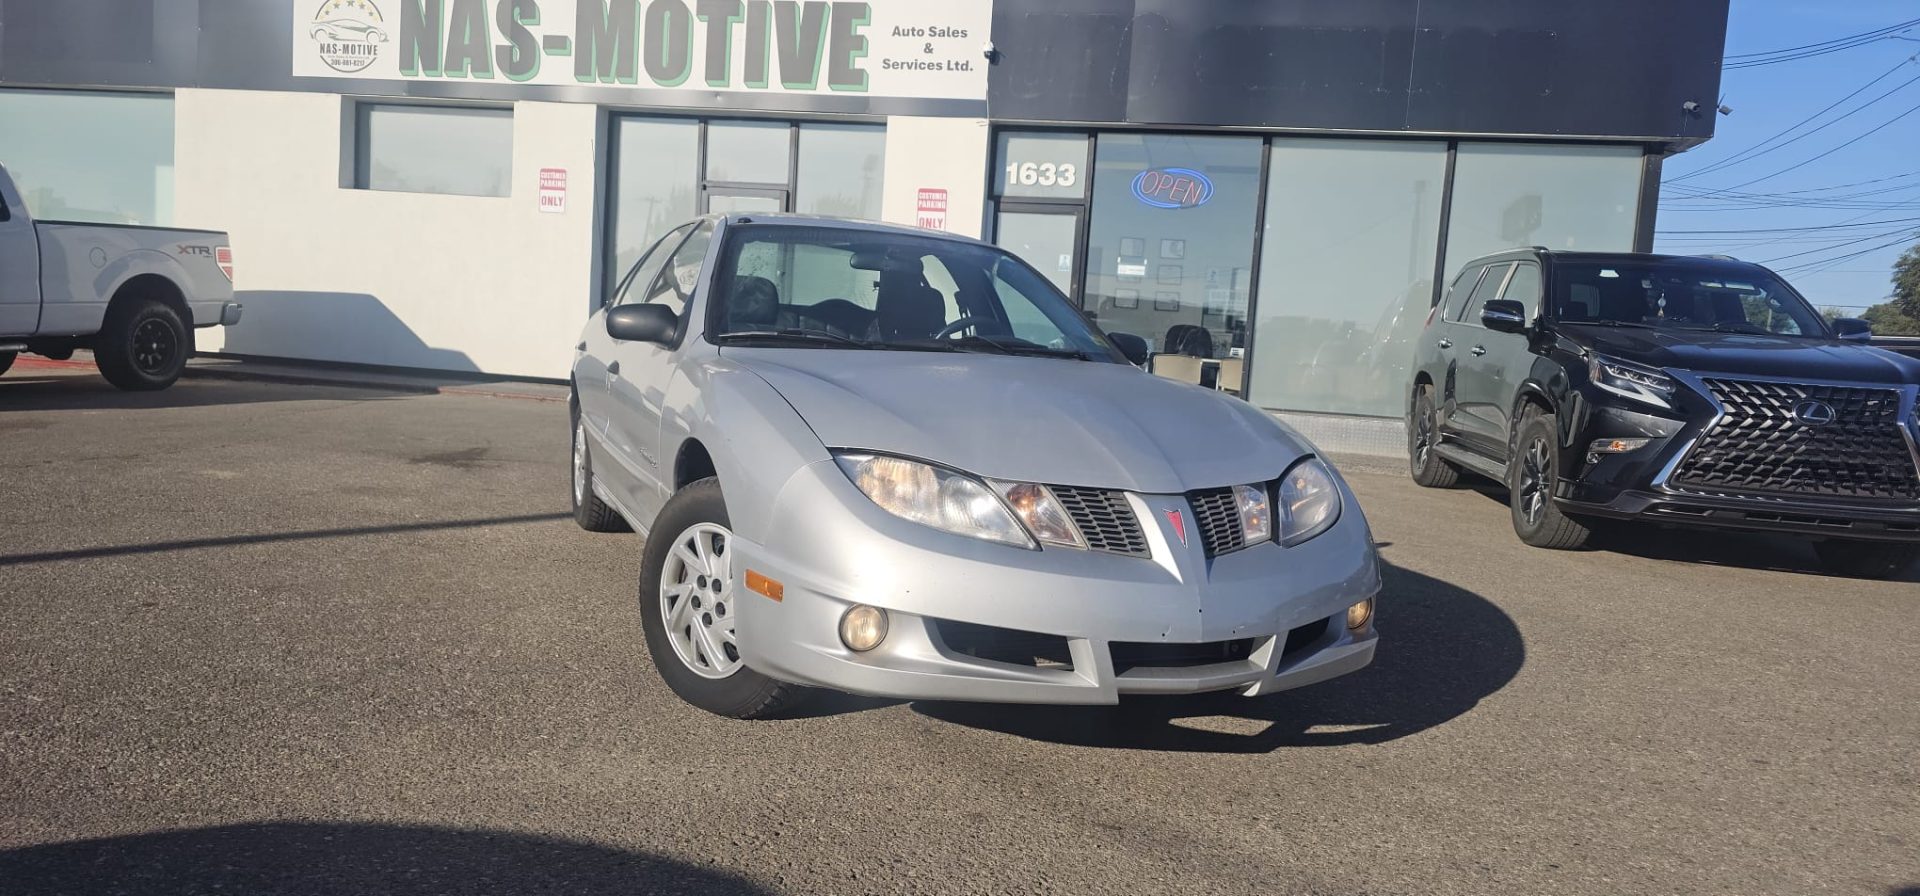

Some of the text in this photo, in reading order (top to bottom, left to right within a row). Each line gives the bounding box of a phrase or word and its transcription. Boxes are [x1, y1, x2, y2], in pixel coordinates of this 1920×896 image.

[891, 25, 968, 38] Auto Sales
[319, 43, 378, 56] NAS-MOTIVE
[398, 0, 871, 92] NAS-MOTIVE
[923, 42, 934, 54] &
[882, 58, 974, 72] Services Ltd.
[1006, 162, 1076, 187] 1633
[1141, 171, 1202, 204] OPEN
[541, 195, 563, 206] ONLY
[919, 217, 943, 229] ONLY
[176, 244, 213, 255] XTR
